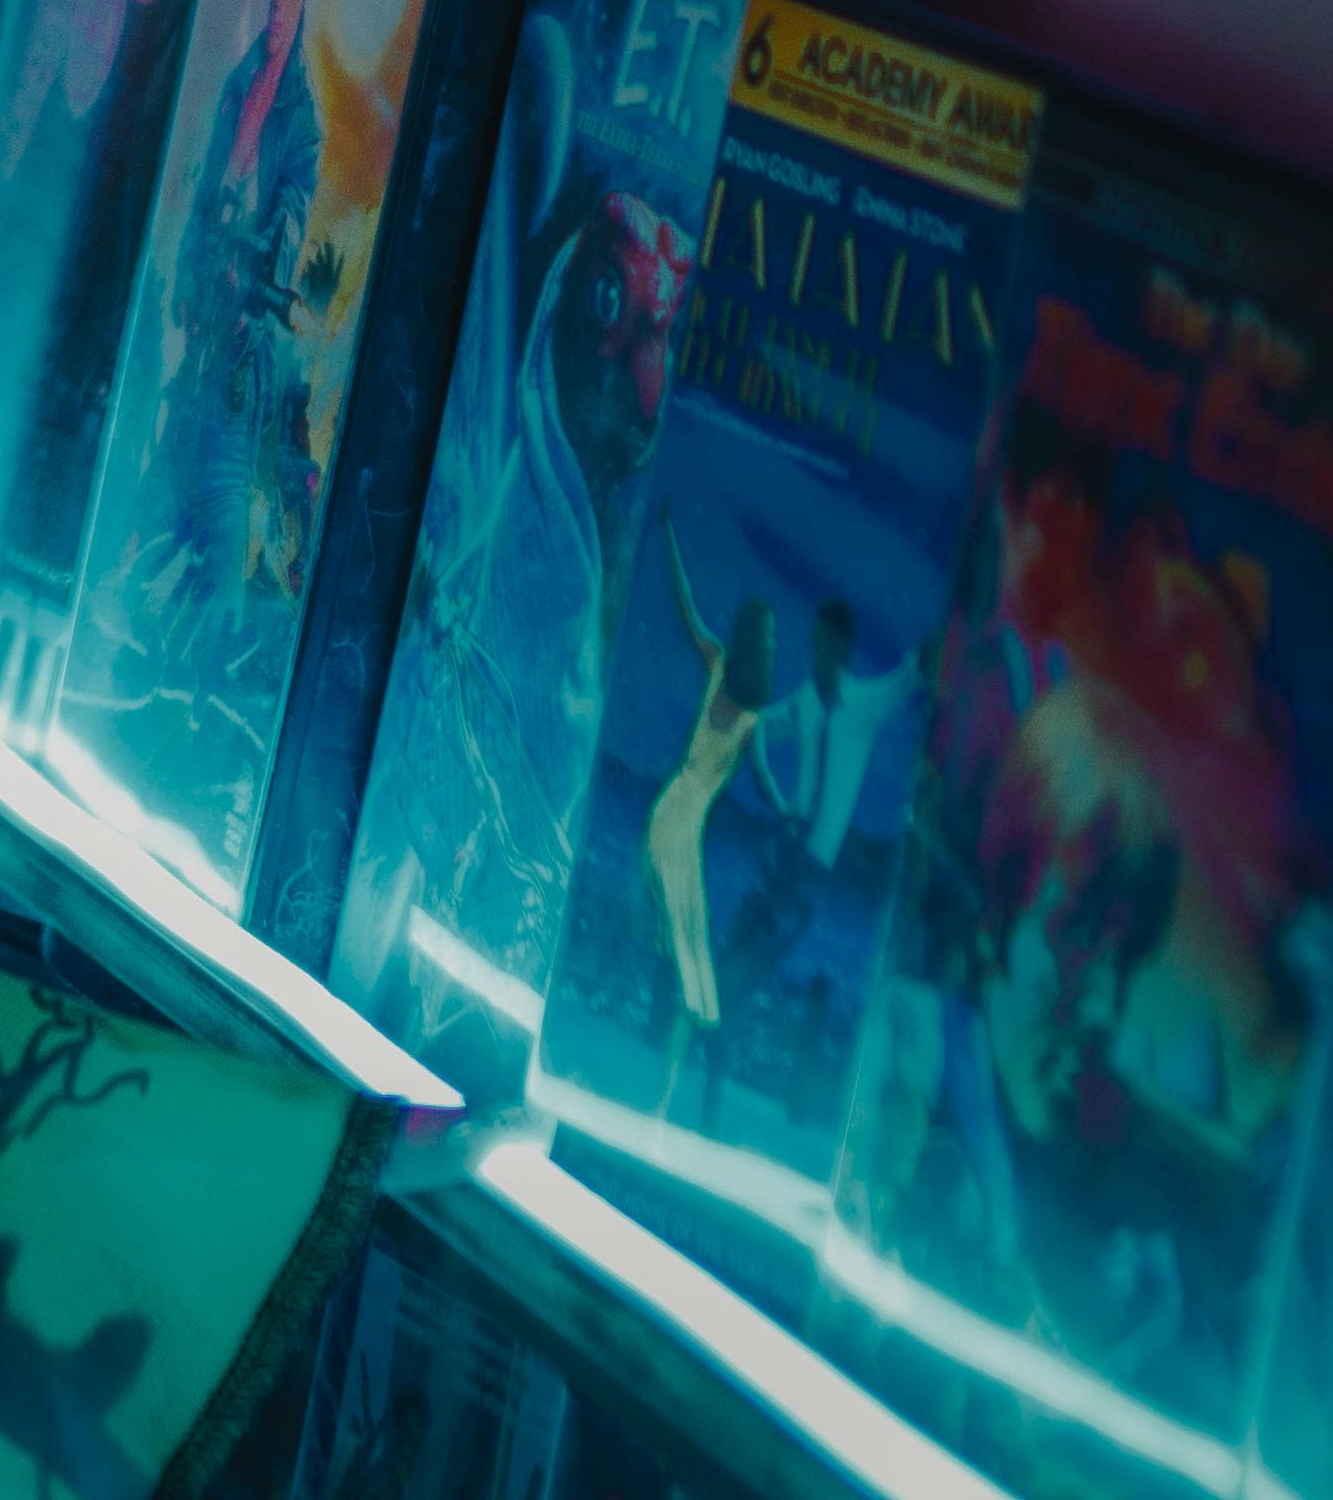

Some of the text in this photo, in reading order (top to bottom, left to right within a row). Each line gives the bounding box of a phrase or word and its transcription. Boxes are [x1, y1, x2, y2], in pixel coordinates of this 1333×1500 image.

[743, 13, 774, 88] 6
[799, 28, 949, 125] ACADEMY
[767, 153, 841, 206] GOSLING
[907, 204, 969, 256] STONE
